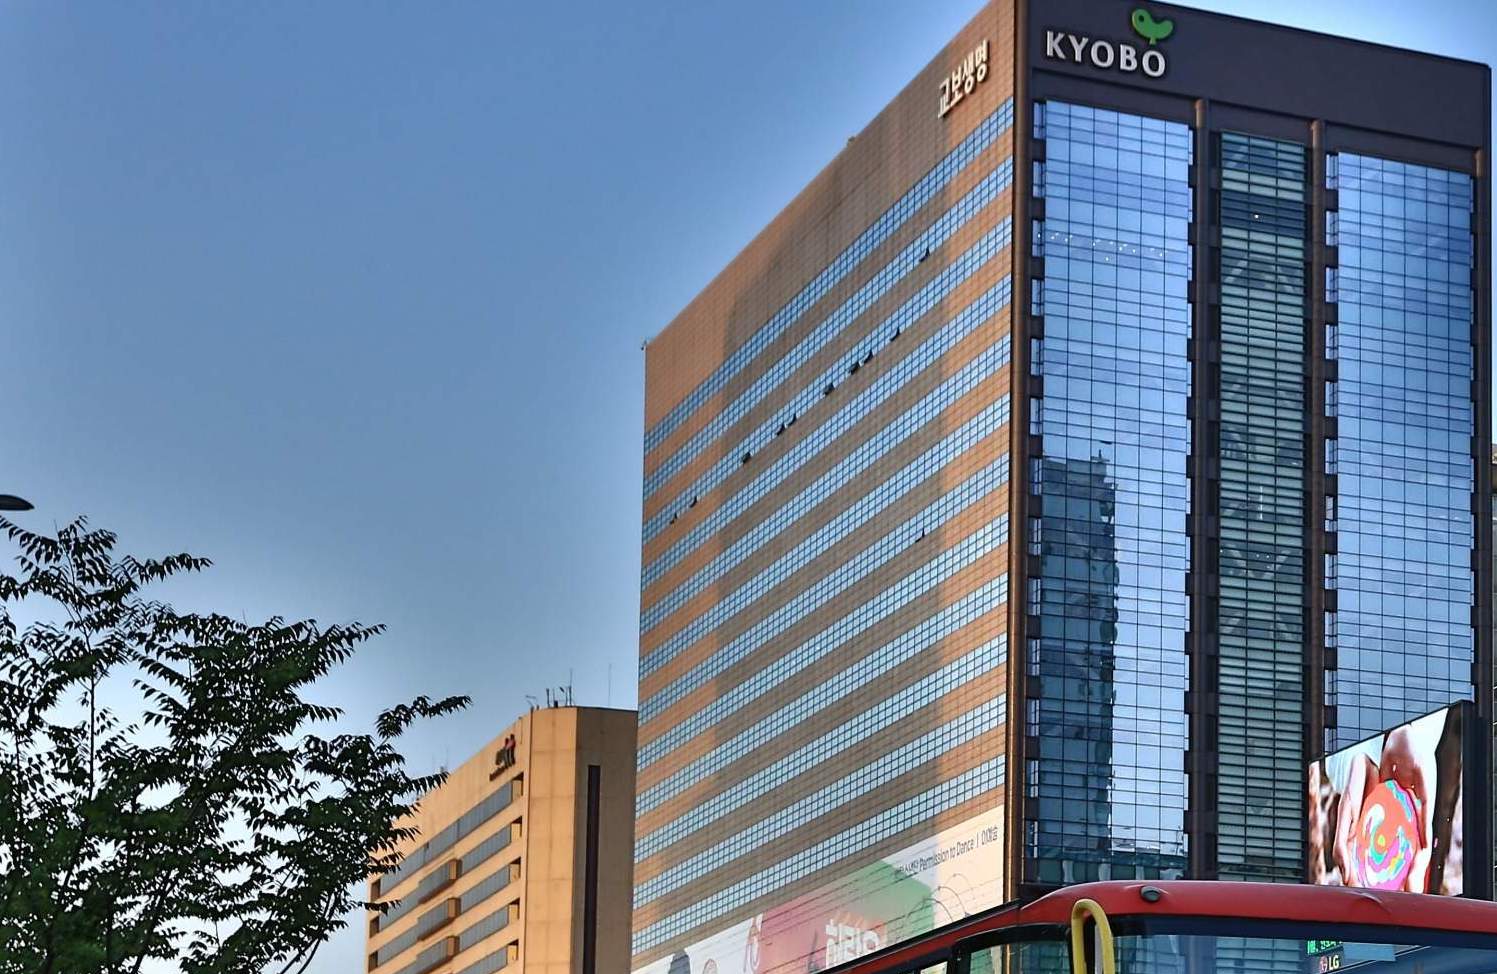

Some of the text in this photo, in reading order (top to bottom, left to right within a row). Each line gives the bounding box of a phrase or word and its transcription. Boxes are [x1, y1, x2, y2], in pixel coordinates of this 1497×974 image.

[1046, 30, 1166, 78] KYOBO
[938, 38, 990, 119] 교보생명
[956, 838, 974, 856] Dance
[1328, 955, 1339, 971] LG
